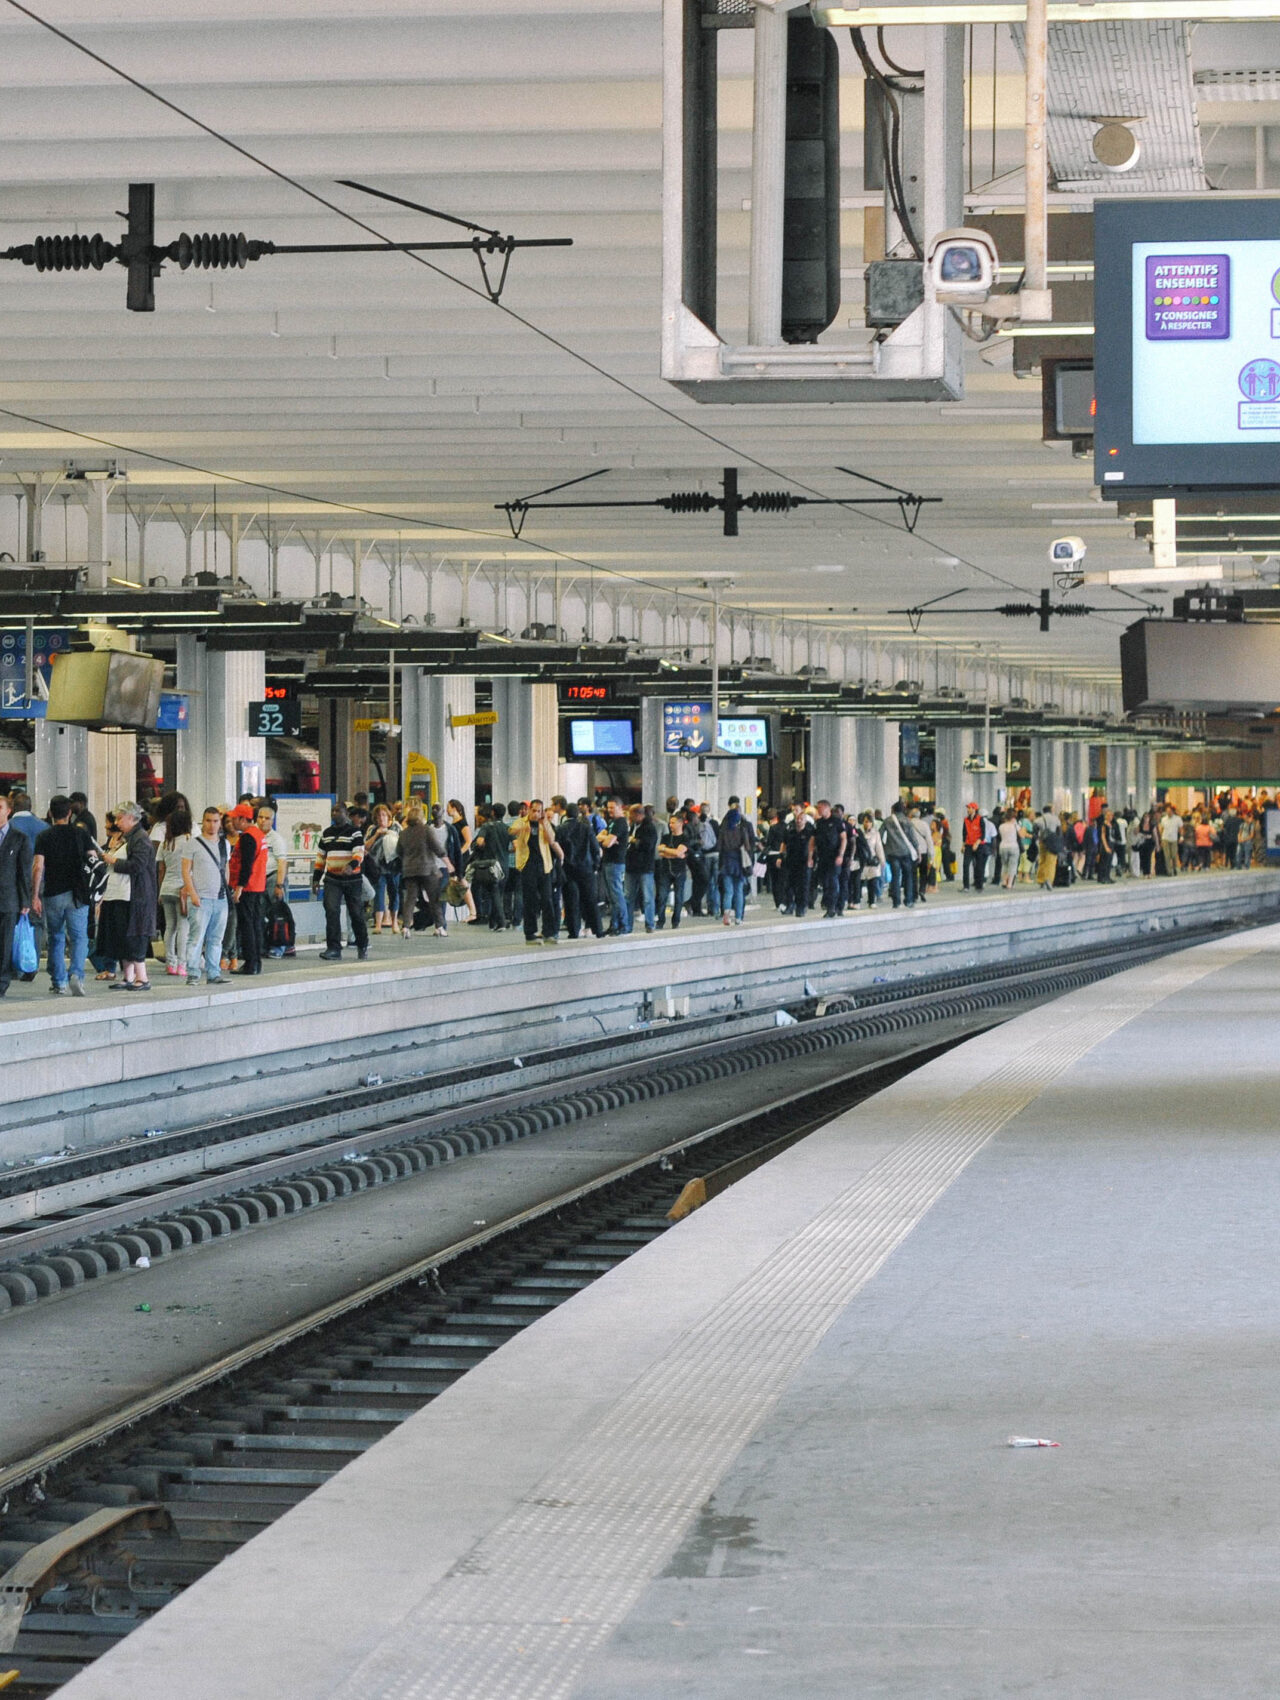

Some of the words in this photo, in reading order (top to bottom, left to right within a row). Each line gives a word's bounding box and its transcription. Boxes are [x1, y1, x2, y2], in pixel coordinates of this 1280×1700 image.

[1154, 264, 1219, 276] ATTENTIFS
[1155, 277, 1218, 289] ENSEMBLE
[1154, 312, 1161, 321] 7
[1162, 310, 1219, 321] CONSIGNES
[1168, 321, 1212, 330] RESPECTER
[258, 713, 284, 732] 32
[467, 715, 497, 724] Alarme
